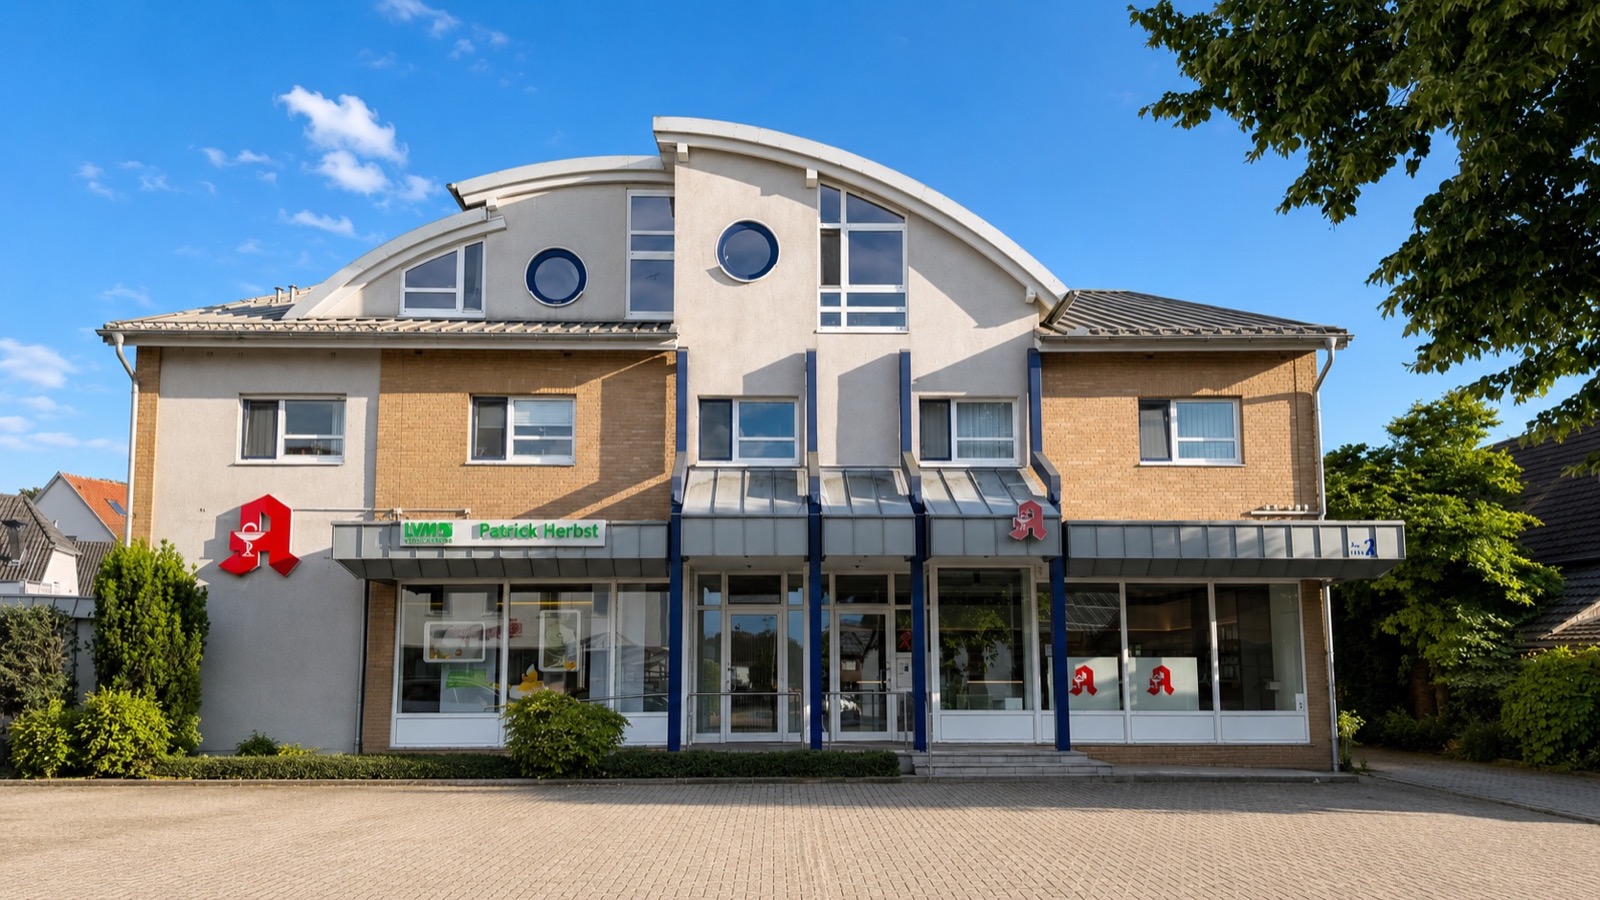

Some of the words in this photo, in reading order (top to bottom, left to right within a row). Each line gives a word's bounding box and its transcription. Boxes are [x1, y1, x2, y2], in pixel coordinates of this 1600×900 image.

[404, 522, 436, 537] LVM
[480, 523, 537, 538] Patrick
[545, 523, 599, 539] Herbst
